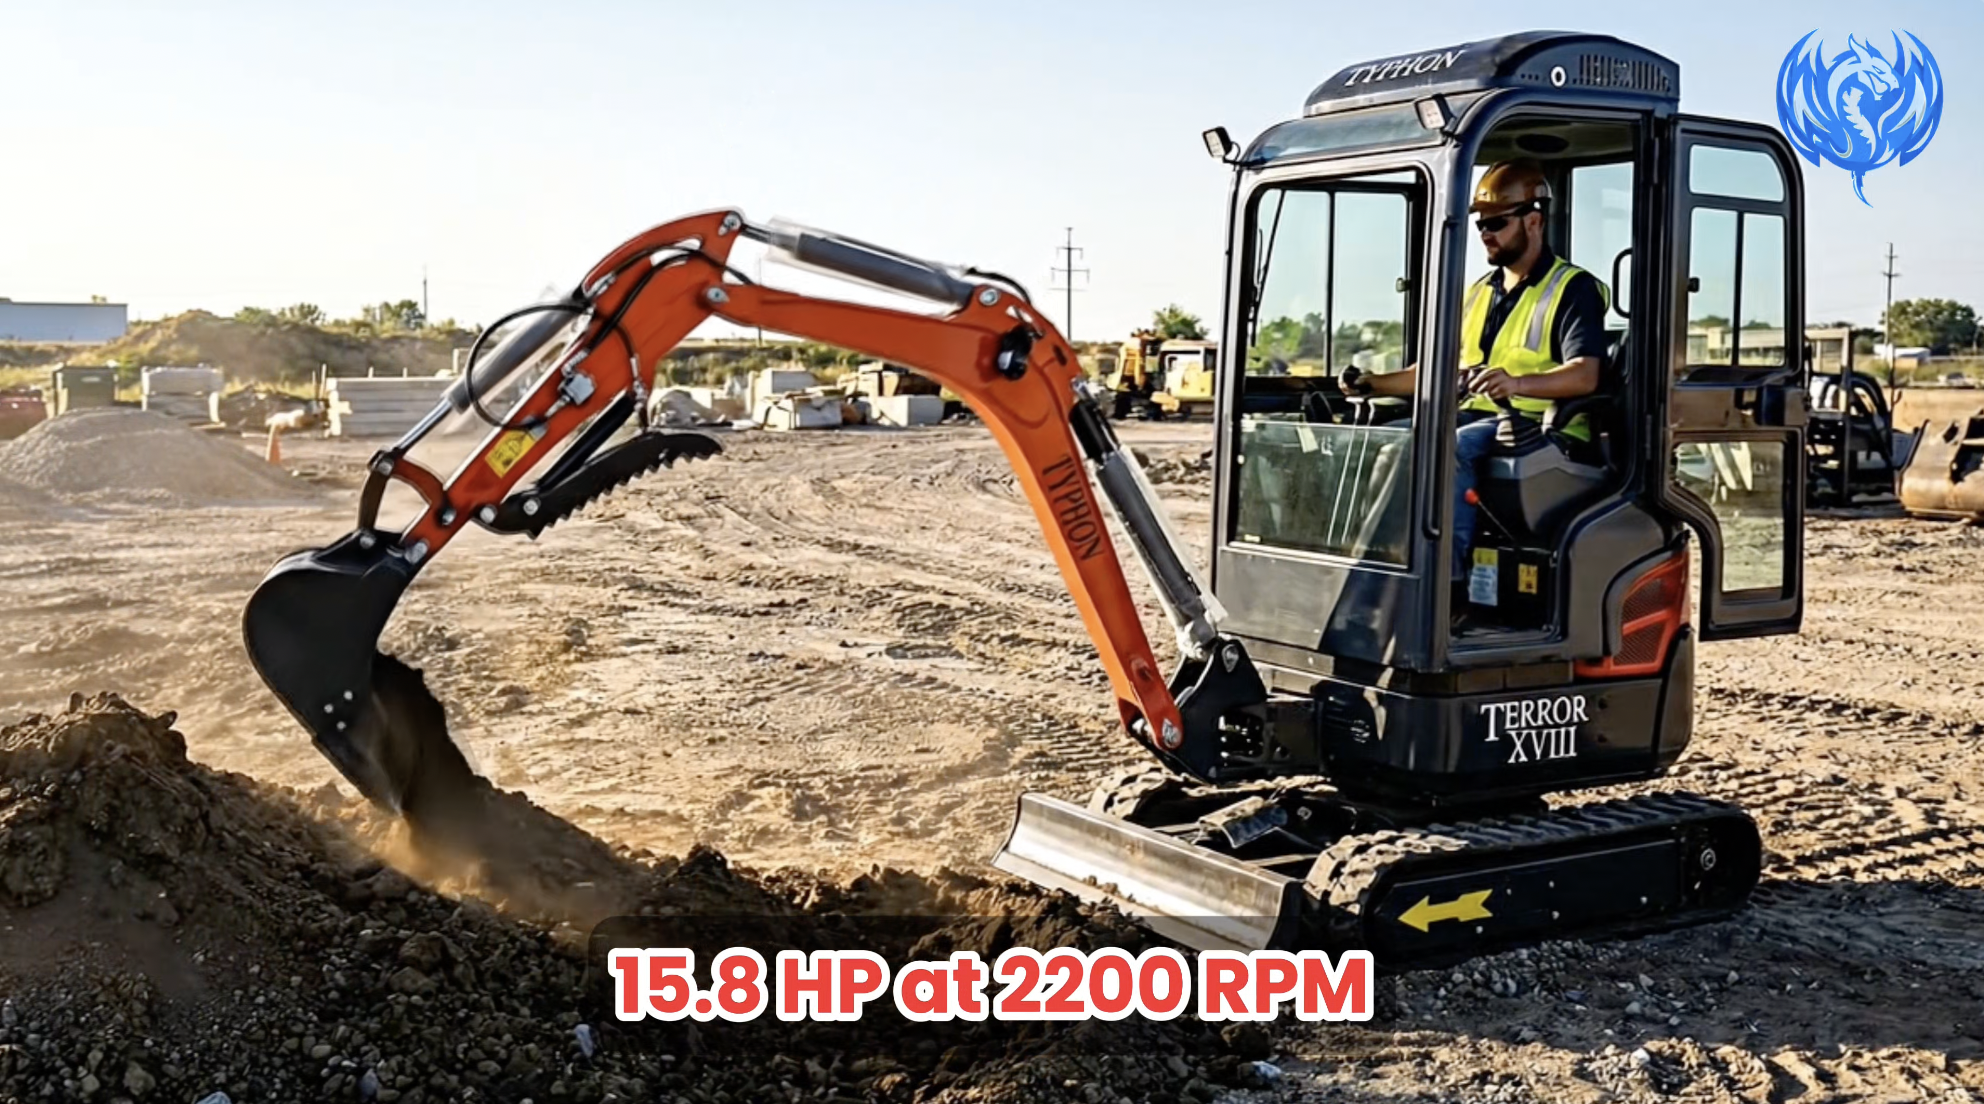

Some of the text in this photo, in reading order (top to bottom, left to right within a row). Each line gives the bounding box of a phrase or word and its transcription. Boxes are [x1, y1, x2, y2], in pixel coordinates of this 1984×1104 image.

[1344, 50, 1465, 87] TYPHON
[1042, 456, 1105, 561] TYPHON
[1480, 695, 1589, 742] TERROR
[1506, 726, 1578, 764] XVIII
